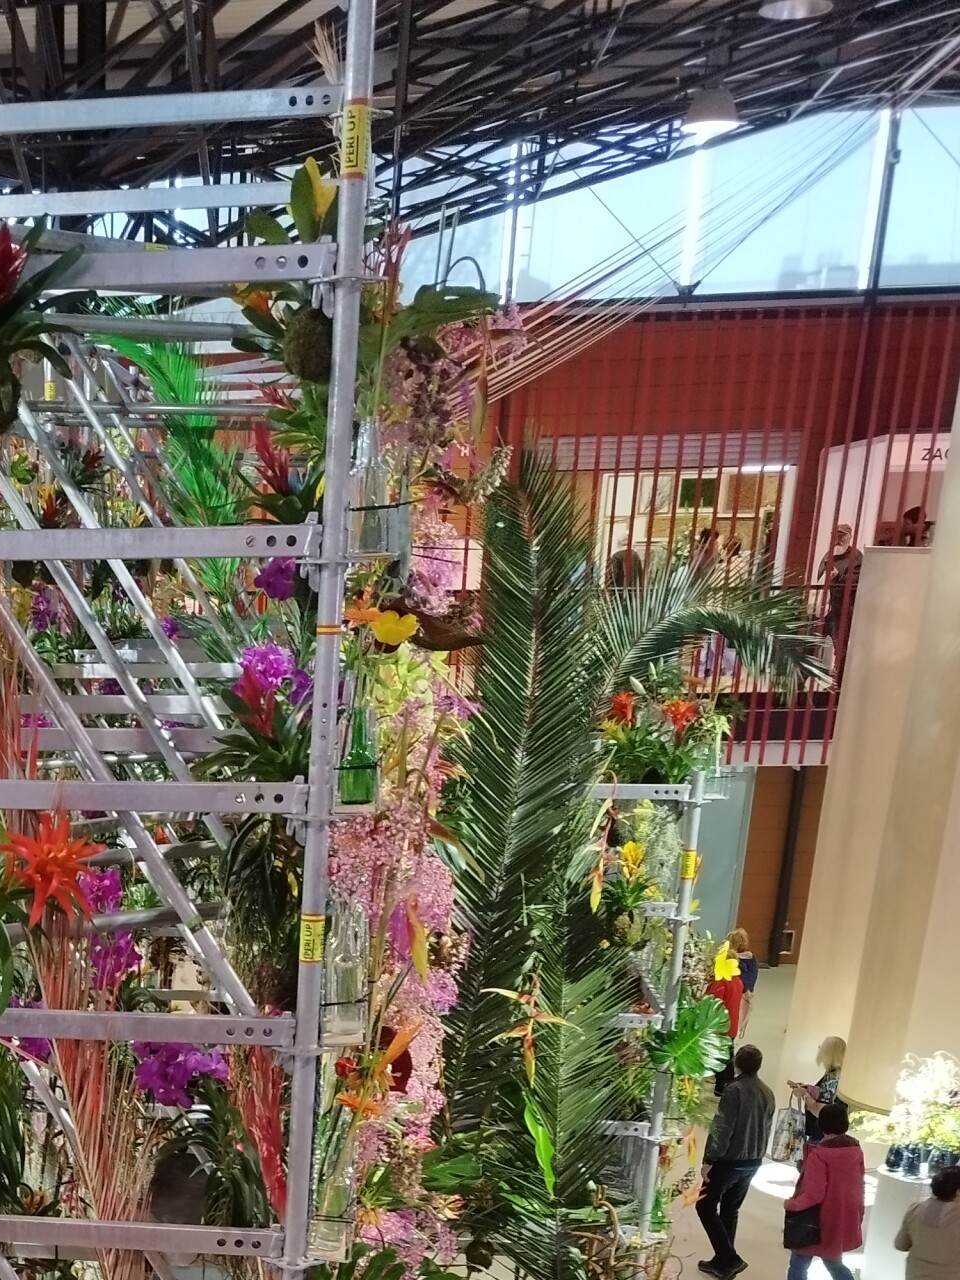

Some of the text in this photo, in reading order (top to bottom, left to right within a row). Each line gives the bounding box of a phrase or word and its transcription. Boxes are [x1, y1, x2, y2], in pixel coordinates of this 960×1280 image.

[345, 109, 356, 164] PERI UP
[304, 923, 313, 956] PERI UP
